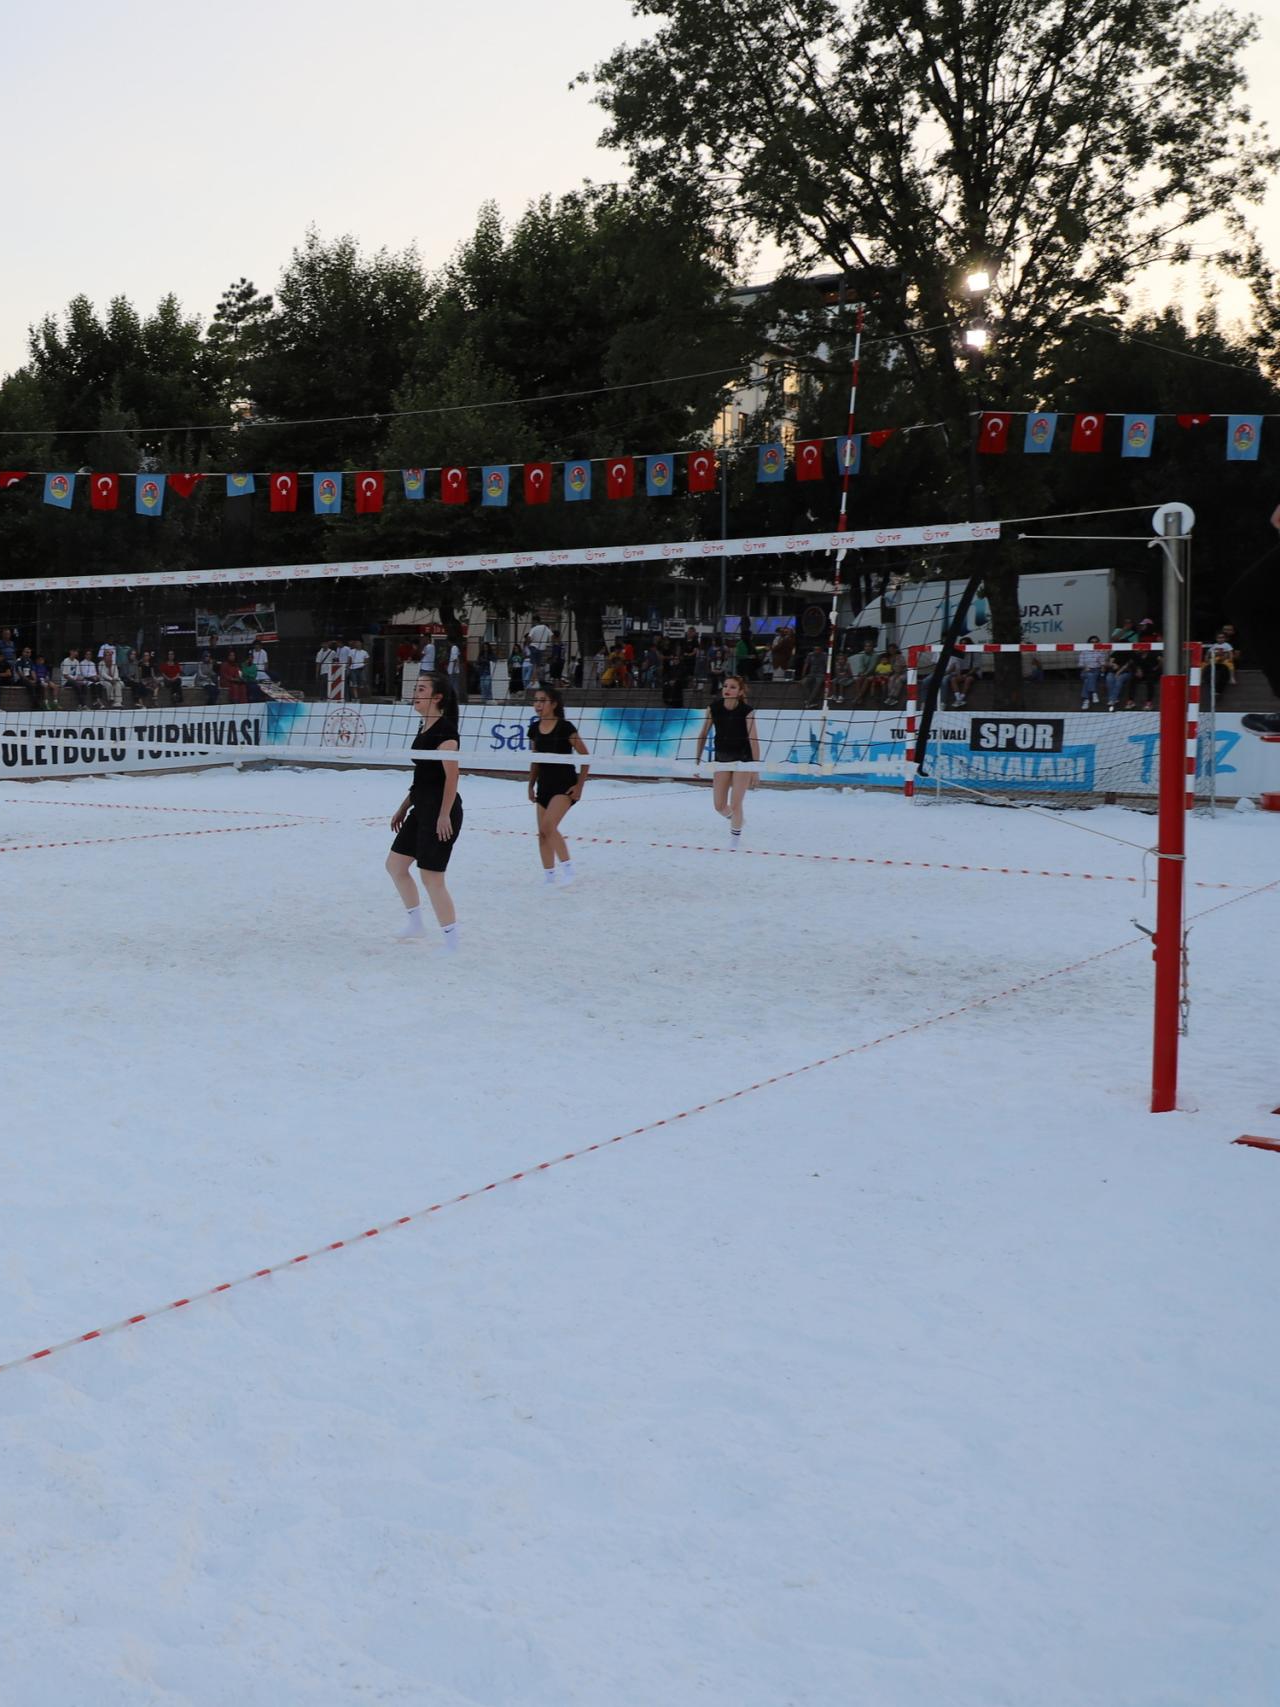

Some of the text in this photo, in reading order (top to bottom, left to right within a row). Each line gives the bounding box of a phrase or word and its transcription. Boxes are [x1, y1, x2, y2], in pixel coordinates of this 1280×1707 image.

[1019, 603, 1063, 618] URAT
[134, 718, 260, 760] TURNUVASI
[890, 729, 910, 739] TU
[979, 722, 1054, 750] SPOR
